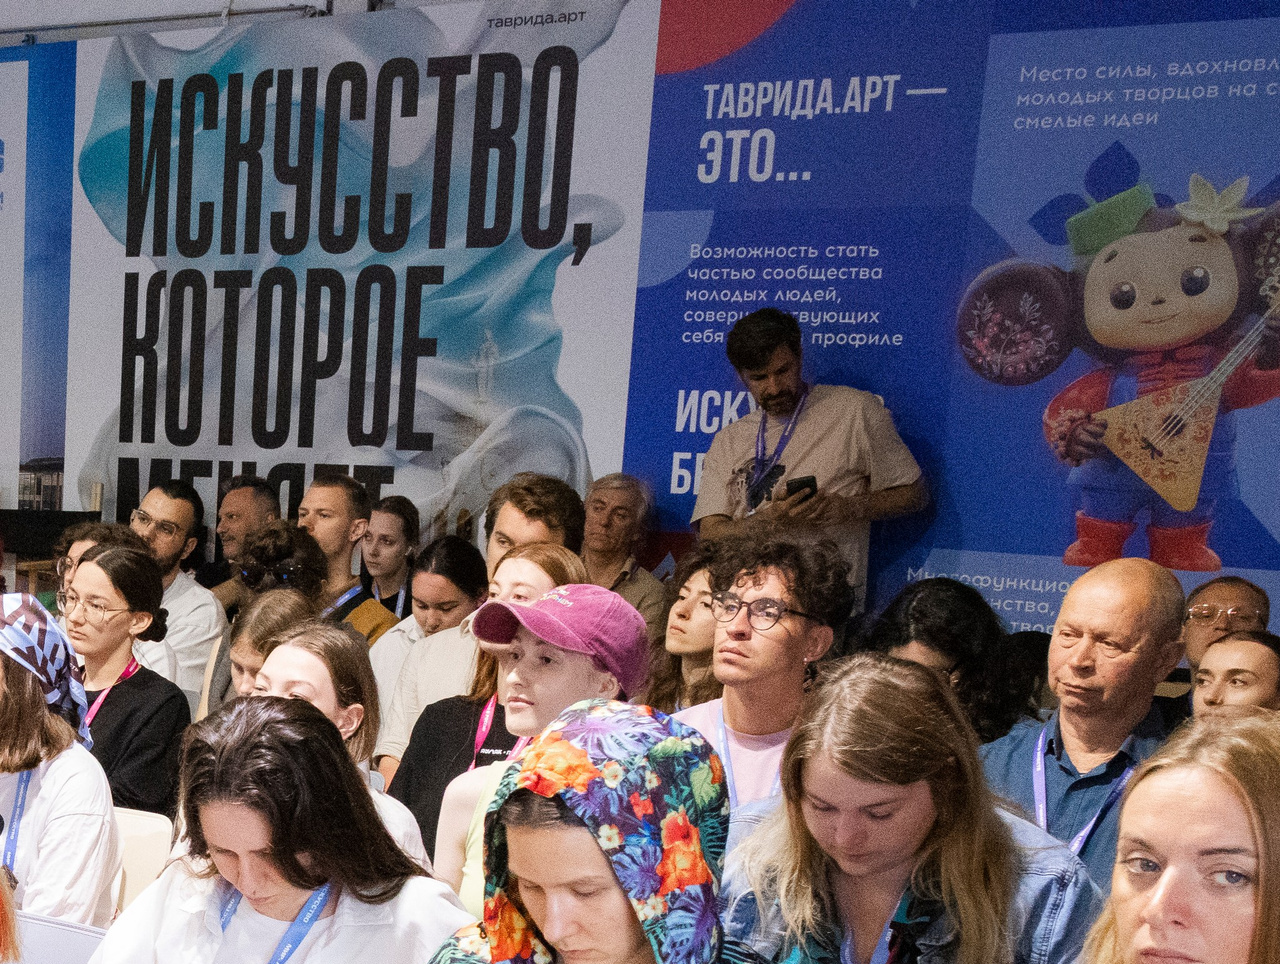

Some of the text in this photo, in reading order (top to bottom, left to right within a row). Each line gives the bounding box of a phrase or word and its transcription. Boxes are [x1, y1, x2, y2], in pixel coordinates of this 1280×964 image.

[487, 10, 587, 29] таврида.арт
[1020, 66, 1087, 82] Место
[1096, 64, 1157, 80] силы,
[703, 74, 902, 120] ТАВРИДА.АРТ
[1017, 90, 1114, 107] молодых
[1123, 85, 1219, 103] творцов
[1228, 83, 1257, 97] на
[1014, 112, 1159, 130] смелые идеи
[125, 45, 594, 267] ИСКУССТВО,
[696, 128, 813, 184] ЭТО...
[689, 243, 880, 259] Возможность стать
[688, 265, 883, 281] частью сообщества
[685, 287, 842, 304] молодых людей,
[682, 330, 904, 349] себя профиле
[118, 264, 445, 453] КОТОРОЕ
